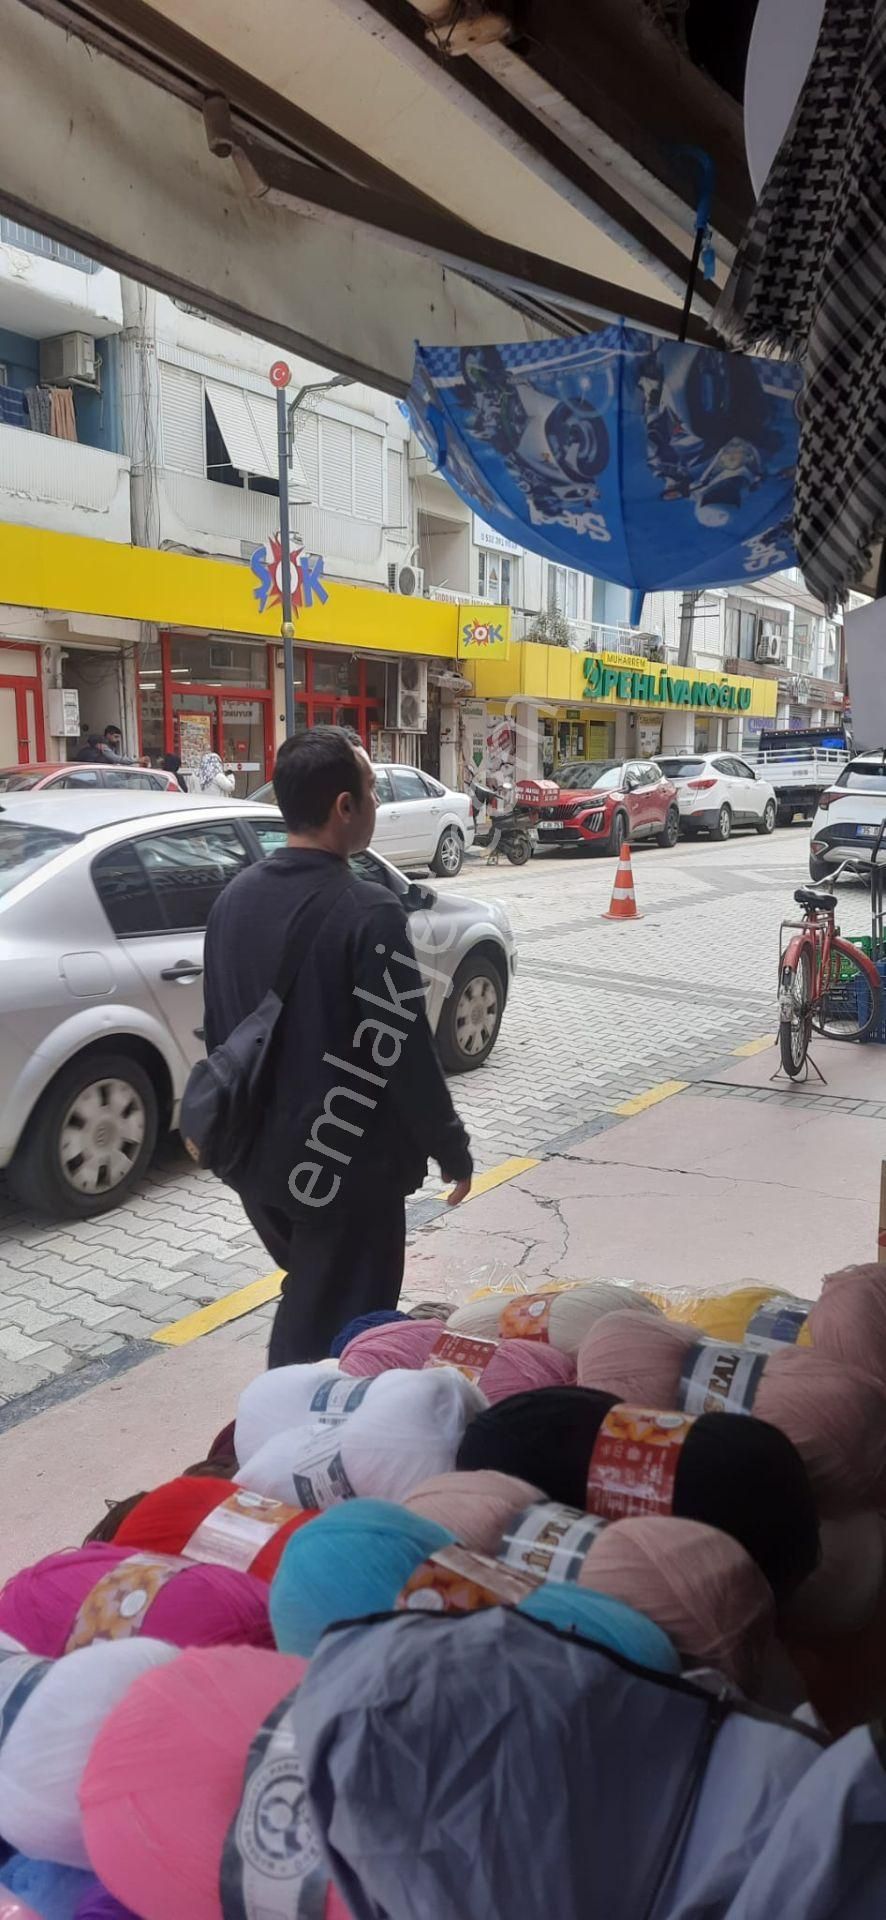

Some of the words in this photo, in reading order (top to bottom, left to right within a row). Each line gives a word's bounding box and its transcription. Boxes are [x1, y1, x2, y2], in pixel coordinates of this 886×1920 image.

[250, 541, 329, 615] ŞOK
[462, 622, 504, 647] ŞOK
[606, 653, 646, 668] MUHARREM
[602, 668, 752, 711] PEHLİVANOĞLU
